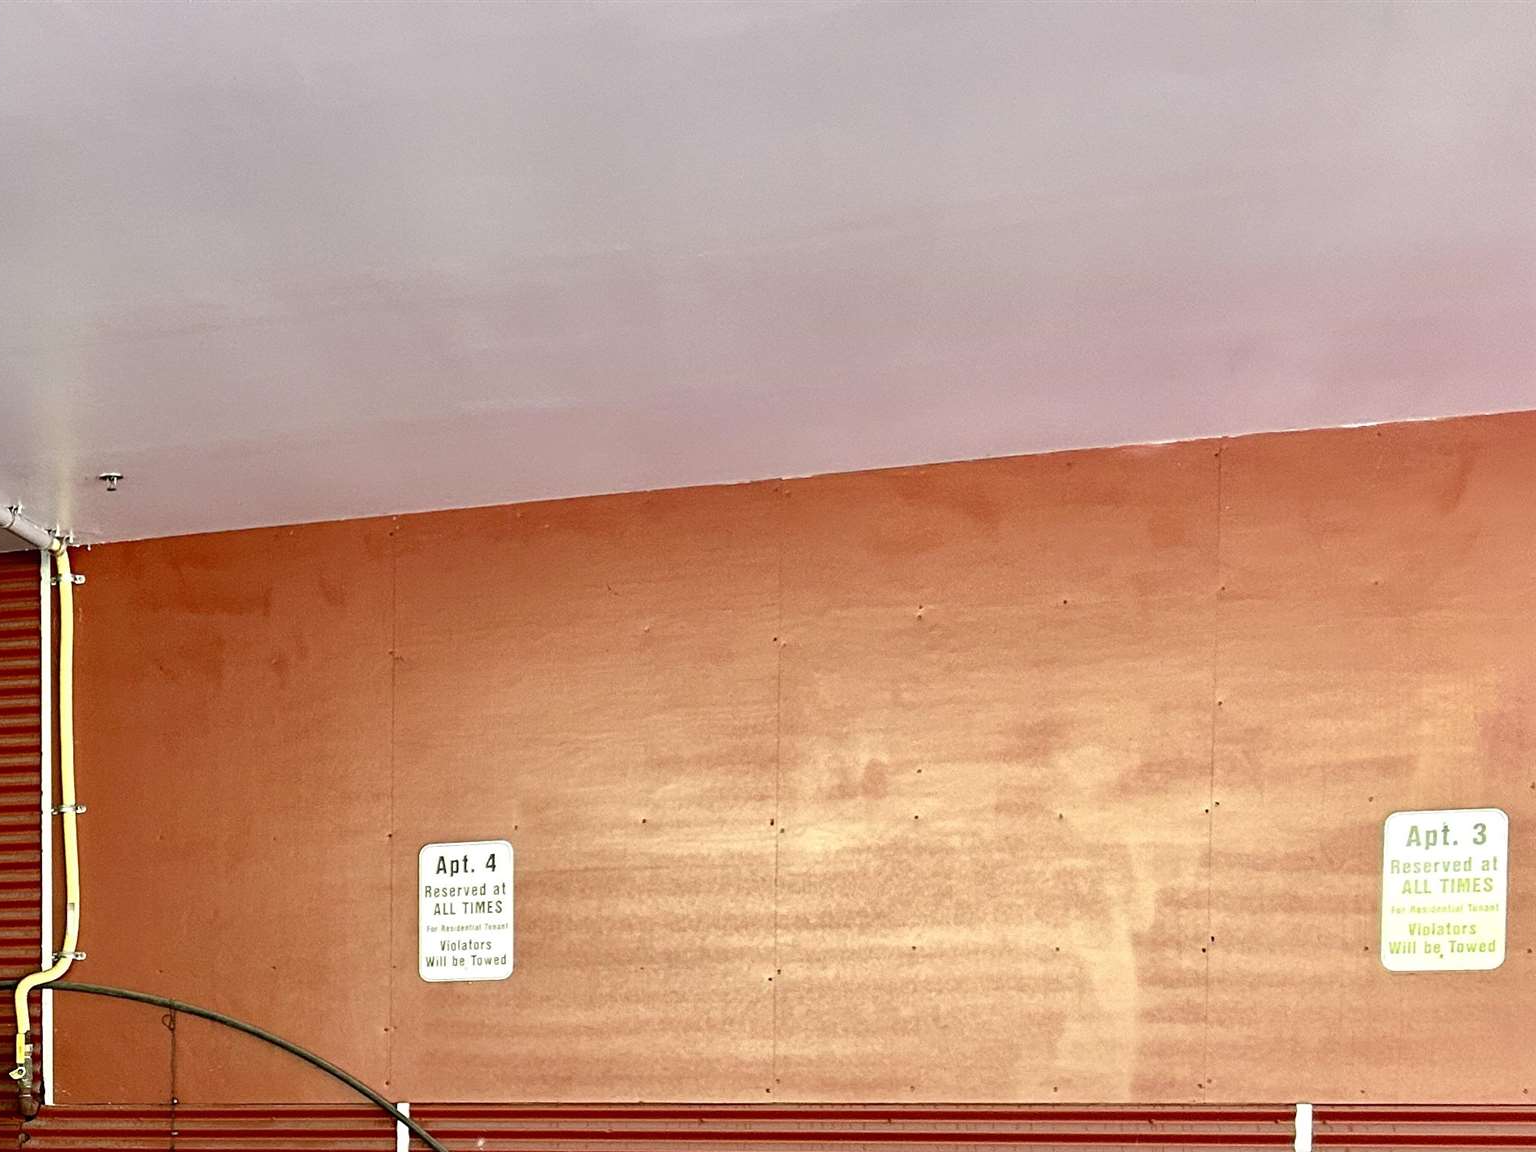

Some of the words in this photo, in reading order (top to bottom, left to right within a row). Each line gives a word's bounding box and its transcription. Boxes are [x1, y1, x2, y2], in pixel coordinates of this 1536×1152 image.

[1406, 824, 1458, 850] Apt.
[1473, 823, 1487, 845] 3
[436, 855, 474, 876] Apt.
[485, 853, 496, 872] 4
[1391, 857, 1472, 874] Reserved
[1481, 856, 1498, 871] at
[425, 883, 486, 898] Reserved
[493, 882, 506, 895] at
[1402, 879, 1431, 894] ALL
[1440, 878, 1493, 893] TIMES
[433, 903, 456, 915] ALL
[462, 900, 503, 914] TIMES
[1408, 923, 1476, 936] Violators
[440, 939, 492, 951] Violators
[1389, 941, 1416, 954] Will
[1424, 941, 1441, 953] be
[1448, 940, 1496, 953] Towed
[426, 956, 446, 967] Will
[452, 956, 465, 966] be
[472, 954, 507, 966] Towed
